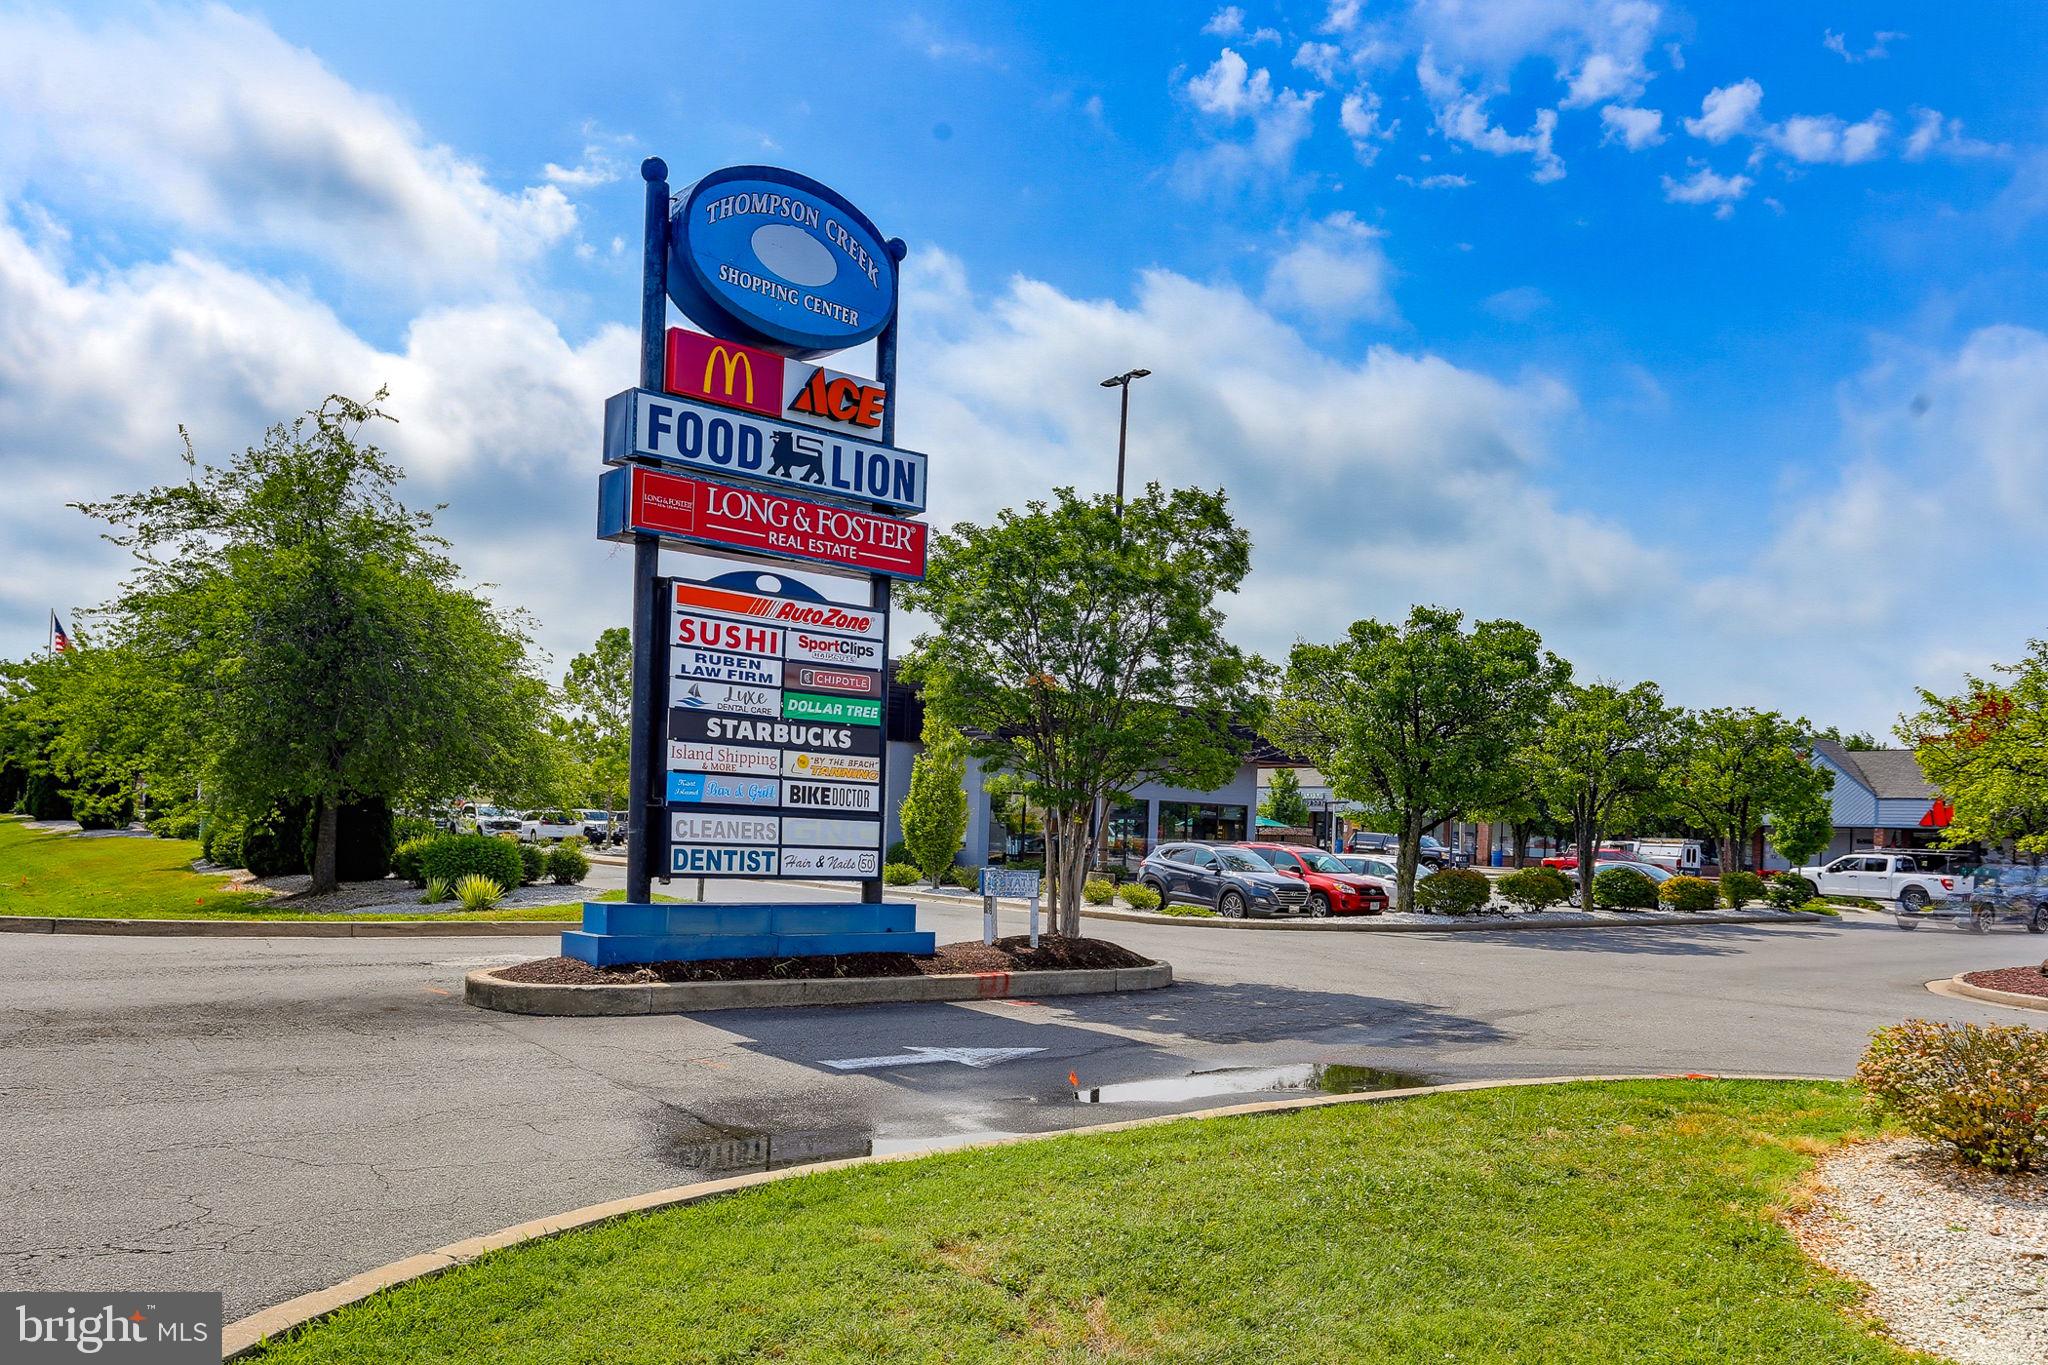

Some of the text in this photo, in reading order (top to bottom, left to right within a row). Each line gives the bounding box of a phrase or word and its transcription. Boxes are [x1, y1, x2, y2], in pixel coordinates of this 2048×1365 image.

[707, 193, 879, 289] THOMPSON CREEK
[719, 264, 860, 327] SHOPPING CENTER
[788, 366, 886, 428] ACE
[648, 404, 916, 503] FOOD LION
[706, 487, 789, 528] LONG
[793, 507, 813, 533] &
[768, 531, 858, 559] REAL ESTATE
[775, 602, 872, 632] AutoZone
[679, 619, 777, 653] SUSHI
[695, 653, 761, 670] RUBEN
[681, 664, 773, 684] LAW FIRM
[817, 674, 868, 688] CHIPOTLE
[723, 686, 768, 705] Luxe
[717, 703, 772, 715] DENTAL CARE
[788, 699, 879, 719] DOLLAR TREE
[706, 717, 852, 749] STARBUCKS
[671, 744, 777, 770] Island Shipping
[702, 762, 737, 771] & MORE
[829, 758, 844, 767] THE
[810, 765, 879, 780] TANNING
[707, 780, 731, 797] Bar
[675, 819, 777, 841] CLEANERS
[673, 848, 776, 873] DENTIST
[784, 855, 873, 870] Hair & Nails 50
